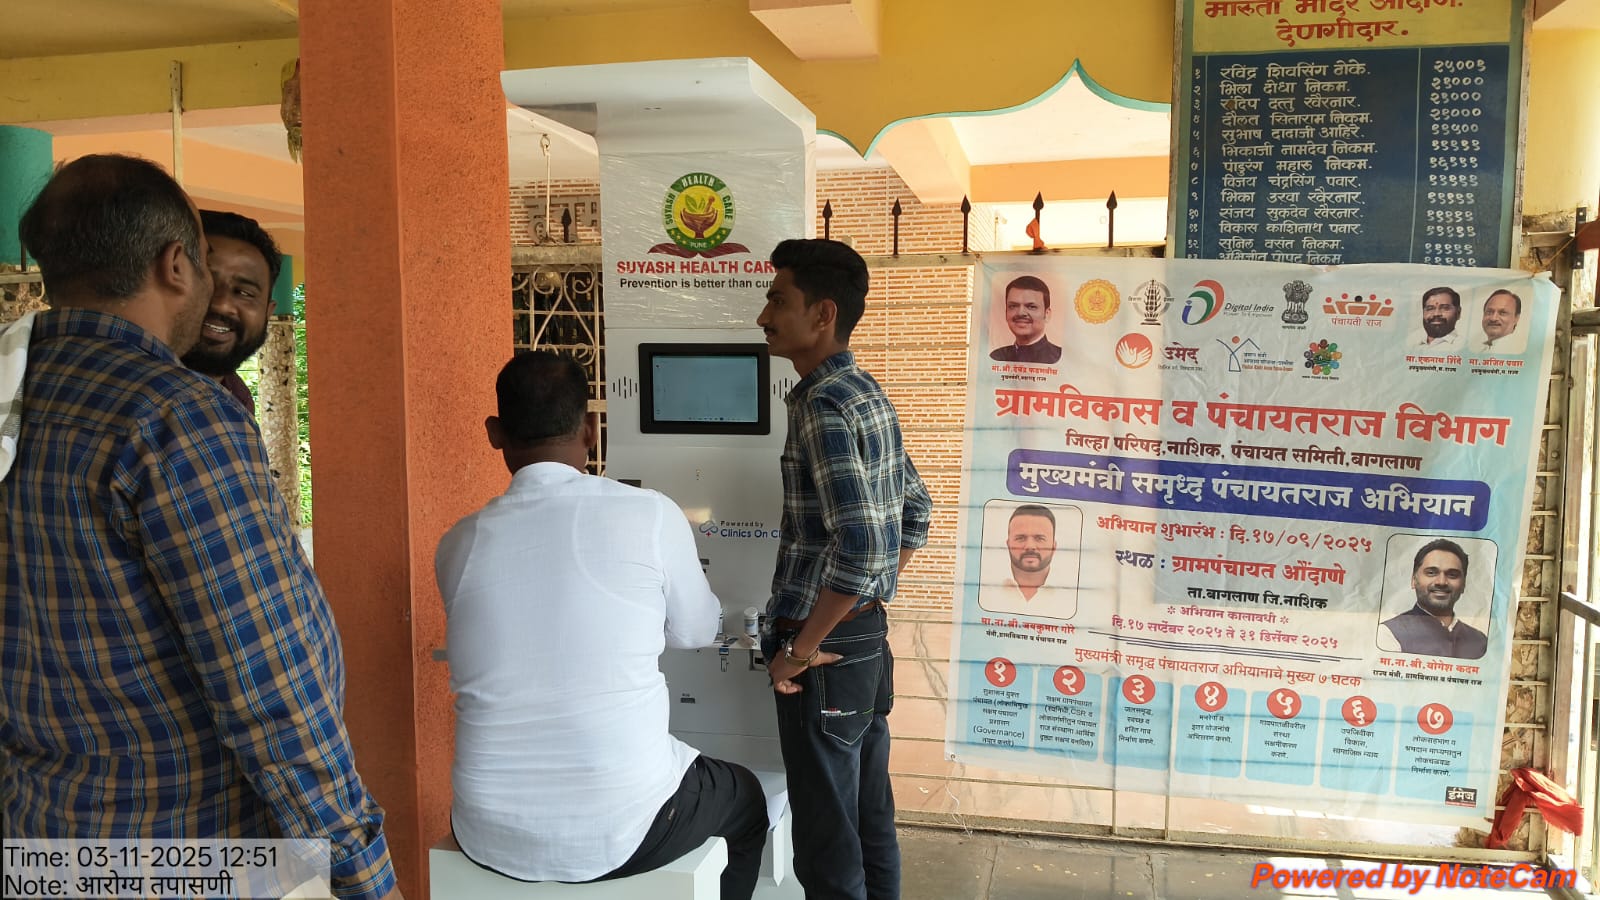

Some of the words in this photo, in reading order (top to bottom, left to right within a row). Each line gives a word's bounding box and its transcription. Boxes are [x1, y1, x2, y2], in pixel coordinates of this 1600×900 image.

[1219, 80, 1253, 96] भिला
[1304, 79, 1351, 93] निकम.
[1330, 110, 1373, 124] निकम.
[1222, 129, 1263, 144] सुभाष
[1271, 127, 1316, 139] दादाजी
[1222, 142, 1274, 157] भिकाजी
[1281, 141, 1328, 156] नामदेव
[1332, 140, 1378, 155] निकम.
[1324, 156, 1373, 171] निकम.
[682, 175, 715, 187] HEALTH
[1222, 174, 1257, 188] विजय
[1326, 175, 1362, 188] पवार.
[1219, 206, 1256, 219] संजय
[1219, 221, 1258, 234] विकास
[1329, 223, 1364, 235] पवार.
[1302, 237, 1345, 250] निकम.
[617, 261, 675, 274] SUYASH
[680, 261, 739, 274] HEALTH
[743, 261, 777, 274] CAR
[620, 278, 678, 289] Prevention
[681, 278, 690, 288] is
[694, 278, 724, 289] better
[728, 278, 752, 288] than
[755, 280, 774, 288] cur
[1224, 302, 1252, 312] Digital
[1253, 304, 1275, 312] India
[995, 384, 1163, 425] ग्रामविकास
[1172, 401, 1197, 427] व
[1207, 392, 1386, 438] पंचायतराज
[1396, 402, 1511, 446] विभाग
[1065, 429, 1109, 452] जिल्हा
[1231, 440, 1288, 462] पंचायत
[1019, 461, 1124, 492] मुख्यमंत्री
[1212, 470, 1352, 508] पंचायतराज
[1361, 484, 1475, 517] अभियान
[721, 529, 751, 537] Clinics
[755, 530, 768, 538] On
[1097, 515, 1156, 535] अभियान
[1161, 521, 1216, 541] शुभारंभ
[1115, 550, 1155, 569] स्थळ
[1172, 554, 1276, 579] ग्रामपंचायत
[1180, 606, 1224, 620] अभियान
[1227, 609, 1276, 624] कालावधी
[1188, 625, 1222, 638] २०२५
[1226, 627, 1235, 639] ते
[1240, 630, 1255, 641] ३१
[1302, 635, 1338, 649] २०२५
[1075, 647, 1122, 664] मुख्यमंत्री
[1158, 656, 1220, 674] पंचायतराज
[1223, 661, 1283, 680] अभियानाचे
[1287, 669, 1316, 685] मुख्य
[1319, 674, 1327, 684] ७
[1331, 673, 1362, 687] घटक
[973, 725, 1025, 739] (Governance)
